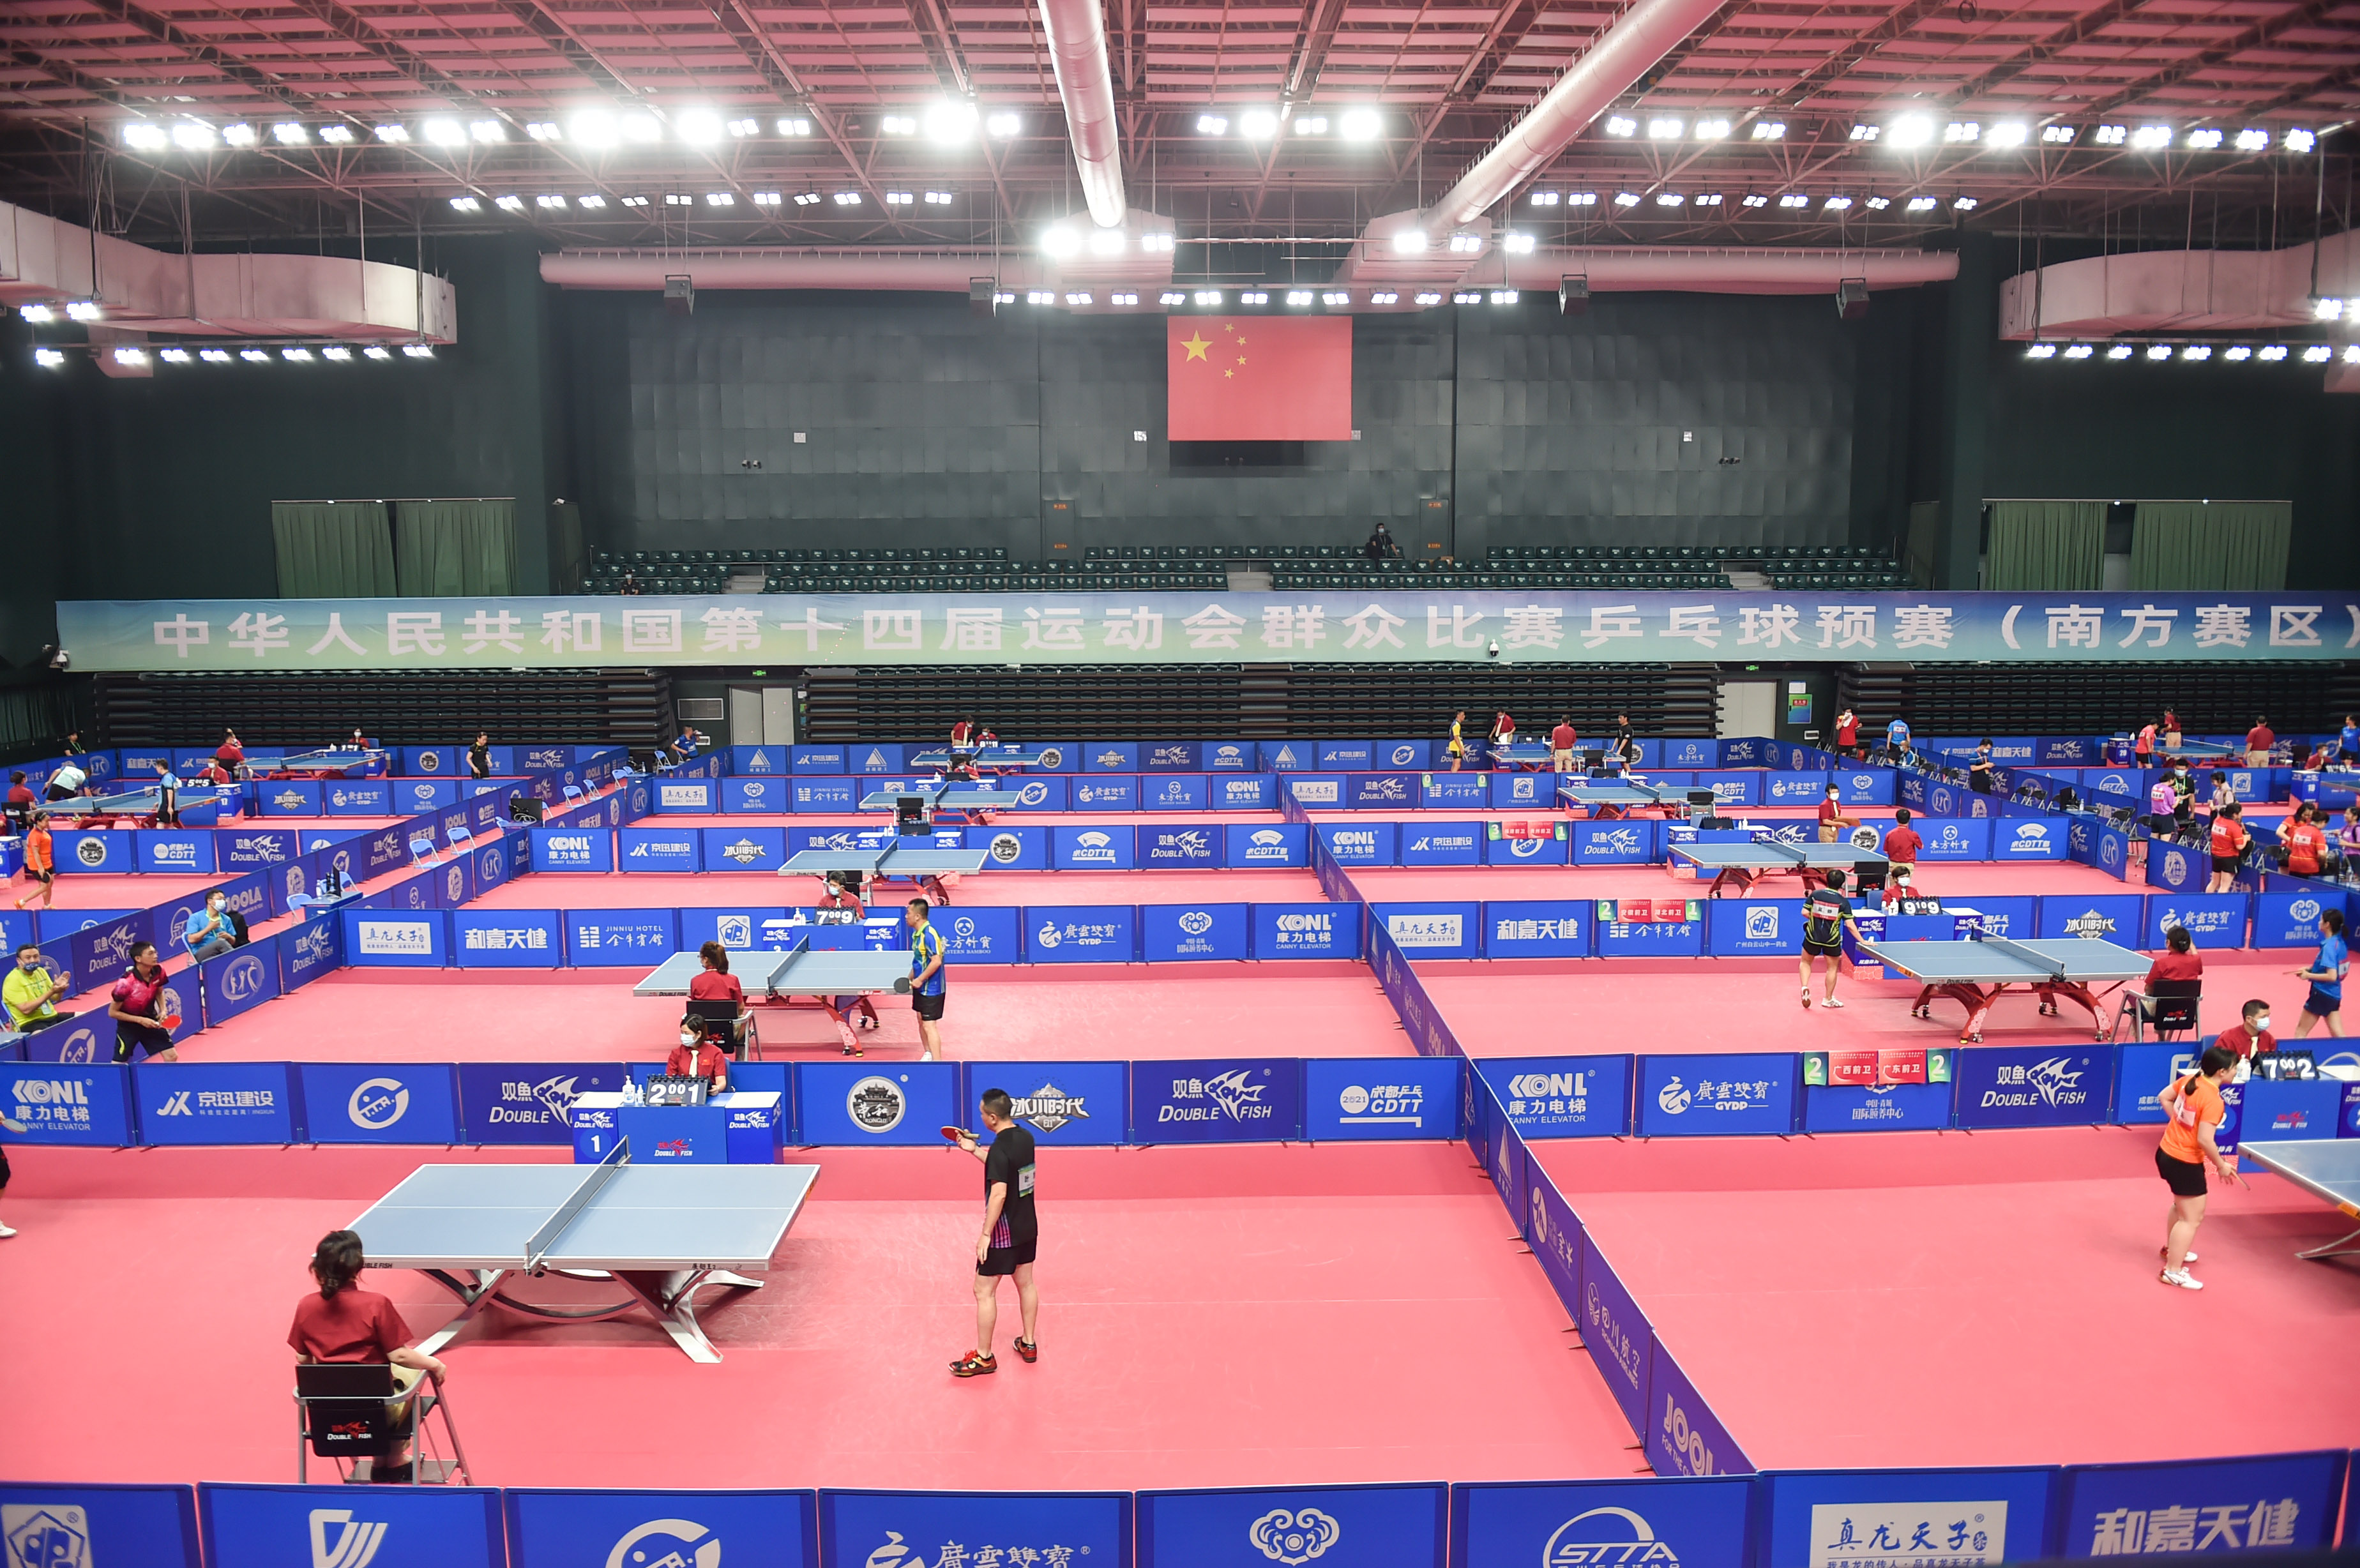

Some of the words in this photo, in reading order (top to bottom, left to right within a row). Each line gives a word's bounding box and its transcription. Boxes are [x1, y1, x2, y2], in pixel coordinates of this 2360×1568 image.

[1359, 792, 1385, 800] DOUBLE
[1492, 824, 1499, 834] 3
[1558, 826, 1565, 836] 1
[231, 852, 260, 861] DOUBLE
[270, 853, 285, 861] FISH
[548, 852, 590, 860] 康力电梯
[1151, 848, 1183, 857] DOUBLE
[1194, 849, 1211, 857] FISH
[1333, 845, 1375, 854] 康力电梯
[1584, 845, 1614, 855] DOUBLE
[1625, 846, 1640, 854] FISH
[1601, 901, 1611, 916] 2
[1690, 901, 1697, 915] 1
[1904, 901, 1916, 914] 9
[1927, 901, 1939, 914] 9
[817, 911, 828, 924] 7
[841, 911, 853, 924] 9
[1497, 918, 1578, 940] 和嘉天健
[465, 928, 547, 949] 和嘉天健
[1276, 932, 1331, 944] 康力电梯
[89, 954, 117, 973] DOUBLE
[292, 954, 318, 973] DOUBLE
[320, 945, 334, 958] FISH
[1809, 1057, 1822, 1077] 2
[1833, 1065, 1872, 1074] 广西前卫
[1882, 1064, 1921, 1074] 广东前卫
[1932, 1055, 1946, 1074] 2
[2263, 1059, 2278, 1078] 7
[2297, 1059, 2315, 1078] 2
[197, 1090, 274, 1107] 京迅建设
[649, 1083, 666, 1103] 2
[688, 1083, 699, 1103] 1
[1981, 1091, 2039, 1107] DOUBLE
[2056, 1091, 2086, 1104] FISH
[1158, 1104, 1219, 1122] DOUBLE
[1239, 1105, 1272, 1119] FISH
[1342, 1096, 1366, 1104] 2021
[1370, 1099, 1423, 1113] CDTT
[1508, 1099, 1587, 1116] 康力电梯
[1714, 1101, 1748, 1111] GYDP
[15, 1105, 90, 1122] 康力电梯
[489, 1106, 549, 1124] DOUBLE
[1509, 1116, 1538, 1124] CANNY
[1541, 1115, 1586, 1123] ELEVATOR
[22, 1122, 44, 1131] ANNY
[48, 1122, 91, 1131] ELEVATOR
[591, 1135, 600, 1152] 1
[1601, 1305, 1640, 1378] 四川航空
[1664, 1392, 1727, 1476] JOOL
[1662, 1434, 1673, 1456] FOR
[1672, 1450, 1684, 1469] THE
[1827, 1517, 1970, 1551] 真龙天子
[2089, 1498, 2301, 1557] 和嘉天健
[1551, 1542, 1679, 1564] STTA
